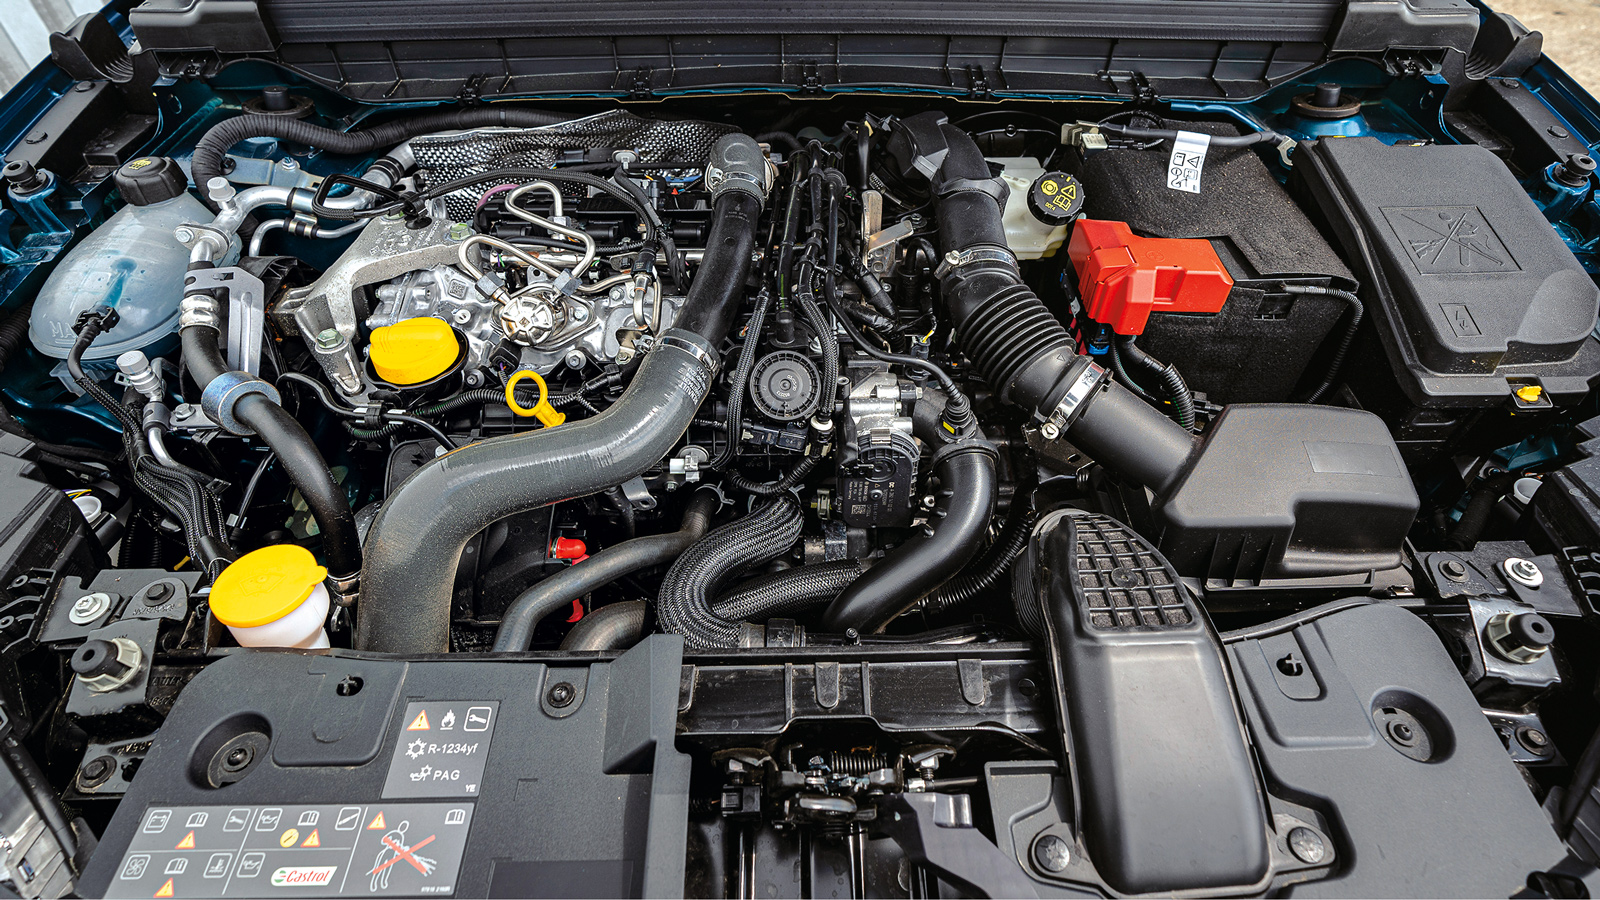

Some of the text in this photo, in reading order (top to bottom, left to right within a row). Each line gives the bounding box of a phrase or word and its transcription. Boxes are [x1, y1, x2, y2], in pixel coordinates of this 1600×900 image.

[427, 743, 479, 756] R-1234yf
[432, 769, 461, 781] PAG
[286, 870, 330, 883] Castrol
